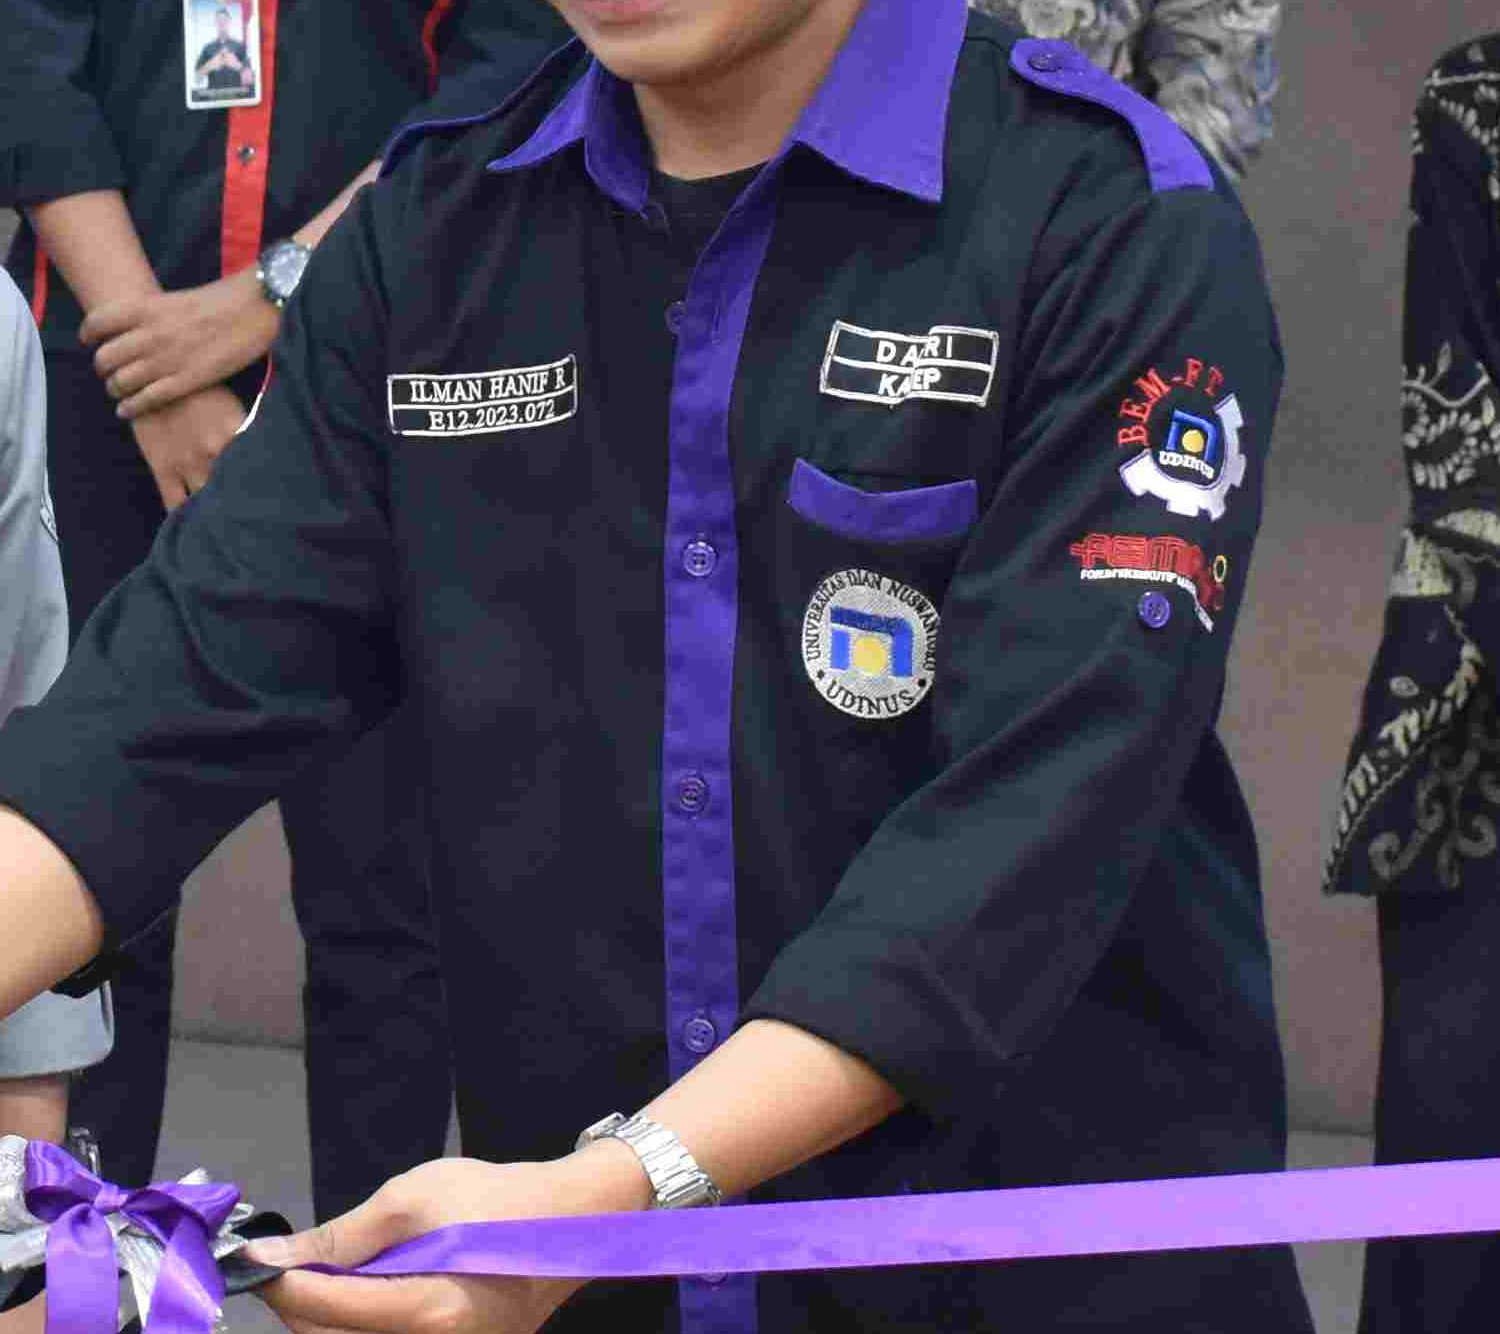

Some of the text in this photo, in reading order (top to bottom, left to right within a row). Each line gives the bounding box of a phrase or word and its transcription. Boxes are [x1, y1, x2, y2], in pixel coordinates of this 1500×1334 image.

[409, 366, 566, 403] ILMAN HANIF R
[428, 398, 556, 431] E12.2023.072
[805, 574, 847, 661] UNIVERSITAS
[846, 570, 883, 591] DIAN
[825, 679, 916, 715] UDINUS
